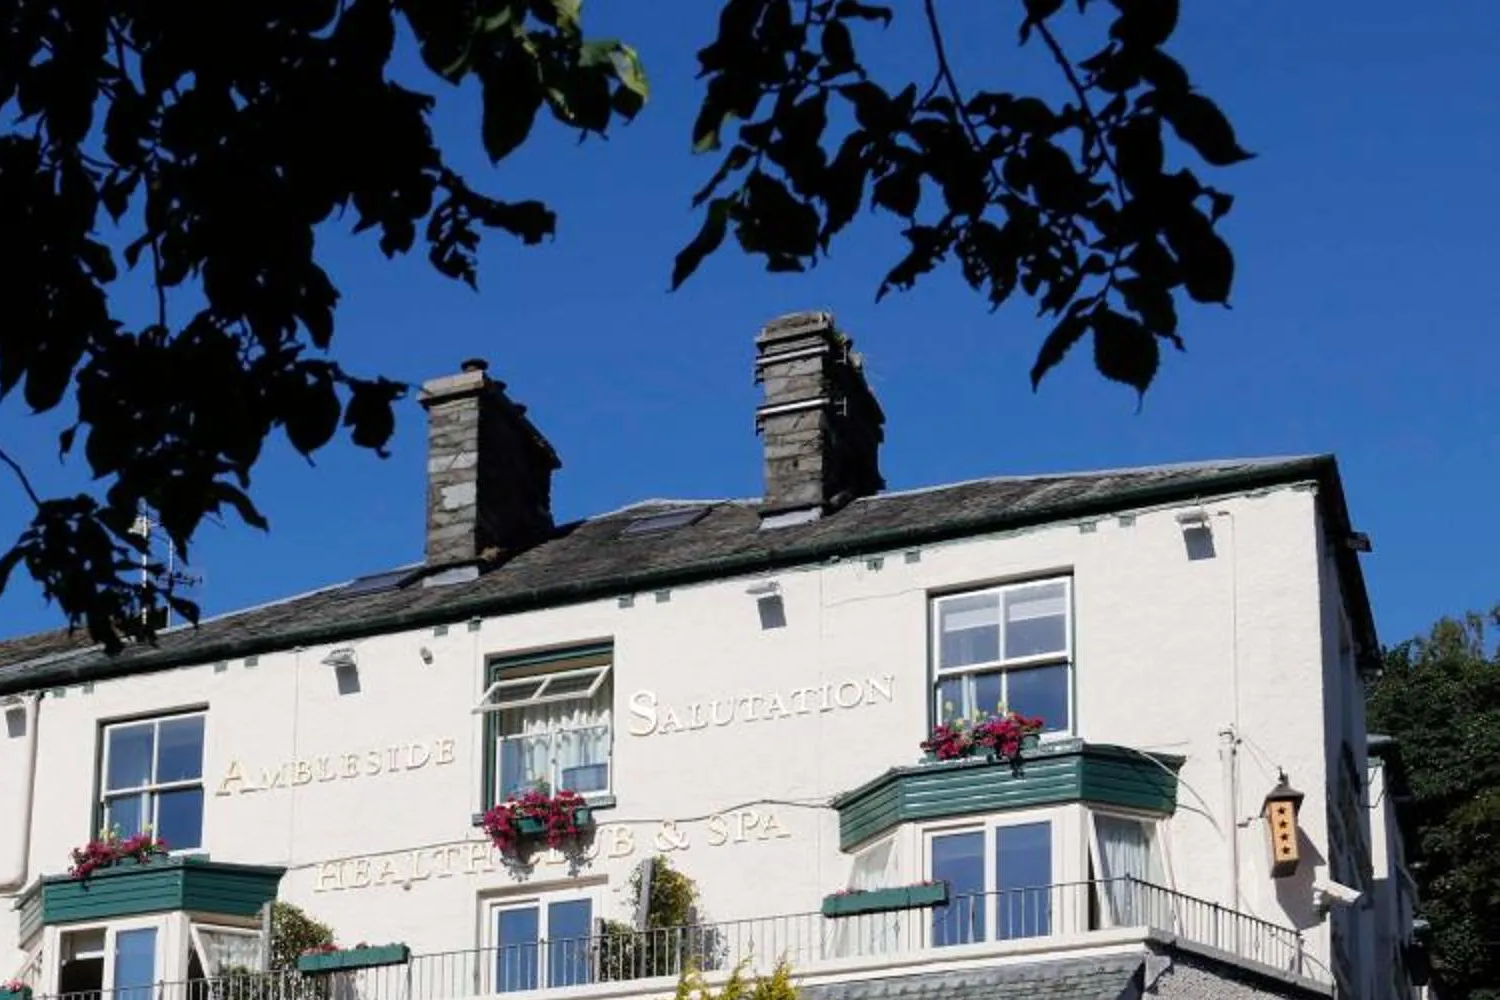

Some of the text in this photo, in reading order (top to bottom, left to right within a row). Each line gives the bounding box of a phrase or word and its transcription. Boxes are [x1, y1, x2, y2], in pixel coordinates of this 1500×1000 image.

[313, 843, 497, 893] HEALTH
[655, 817, 691, 853] &
[706, 812, 792, 847] SPA
